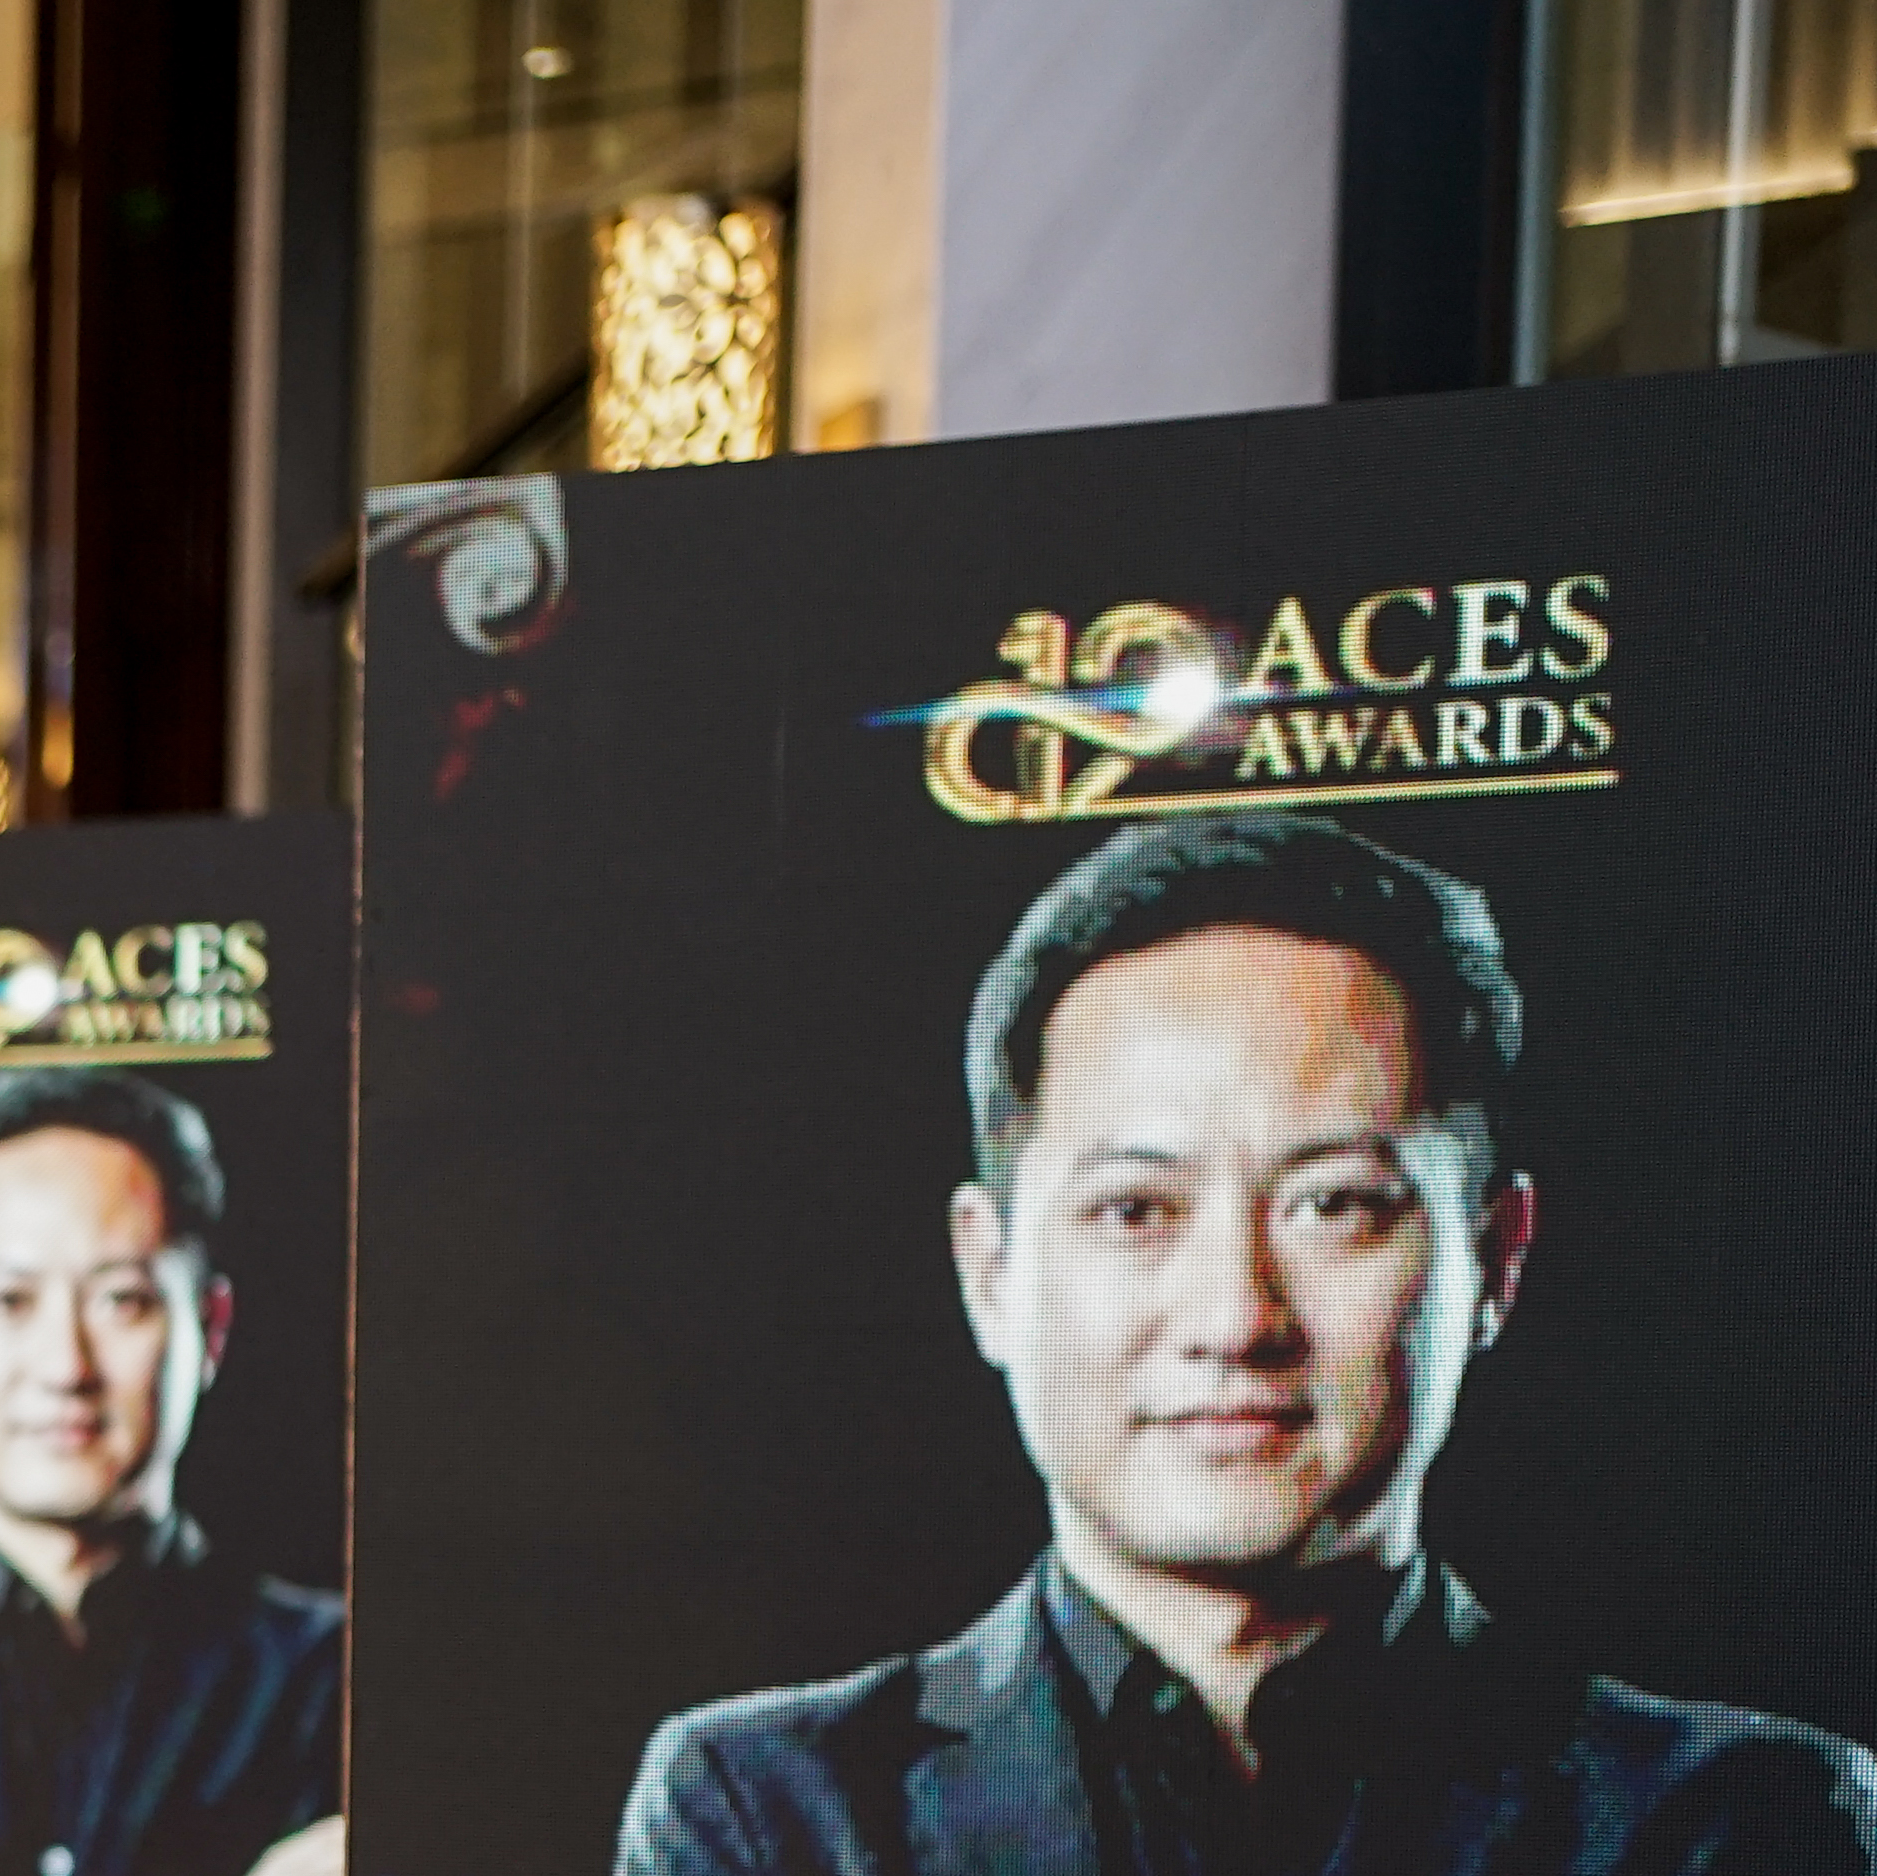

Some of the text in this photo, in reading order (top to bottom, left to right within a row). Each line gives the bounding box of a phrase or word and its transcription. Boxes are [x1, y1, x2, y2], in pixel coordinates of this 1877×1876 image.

[1247, 572, 1613, 698] ACES
[1234, 691, 1617, 782] AWARDS
[63, 919, 269, 1000] ACES
